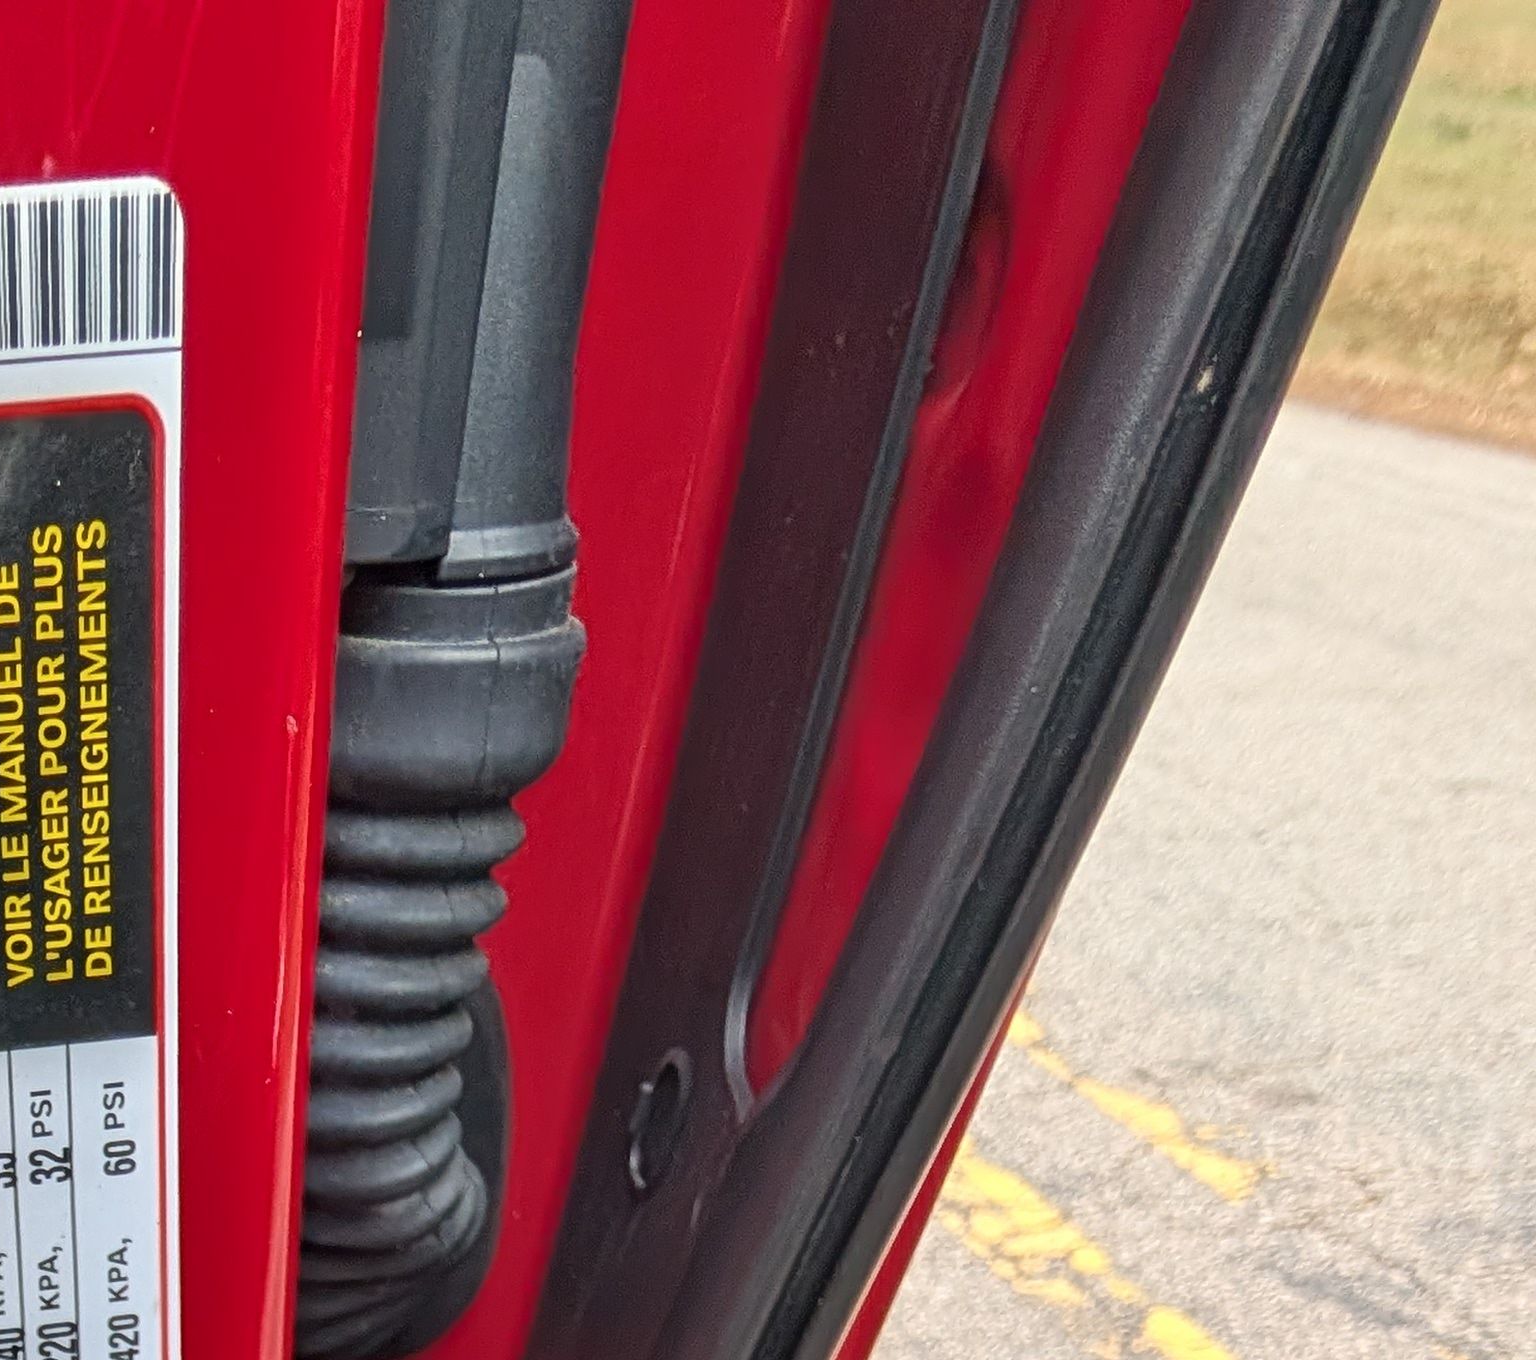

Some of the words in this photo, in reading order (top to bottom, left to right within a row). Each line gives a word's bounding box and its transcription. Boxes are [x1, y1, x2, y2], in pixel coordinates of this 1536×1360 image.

[32, 525, 64, 641] PLUS
[36, 654, 68, 776] POUR
[76, 519, 111, 915] RENSEIGNEMENTS
[0, 833, 30, 882] LE
[40, 788, 74, 982] L'USAGER
[4, 893, 34, 987] VOIR
[84, 925, 112, 977] DE
[30, 1089, 53, 1139] PSI
[102, 1081, 125, 1130] PSI
[28, 1146, 70, 1185] 32
[102, 1139, 137, 1177] 60
[37, 1246, 63, 1311] KPA,
[107, 1238, 133, 1303] KPA,
